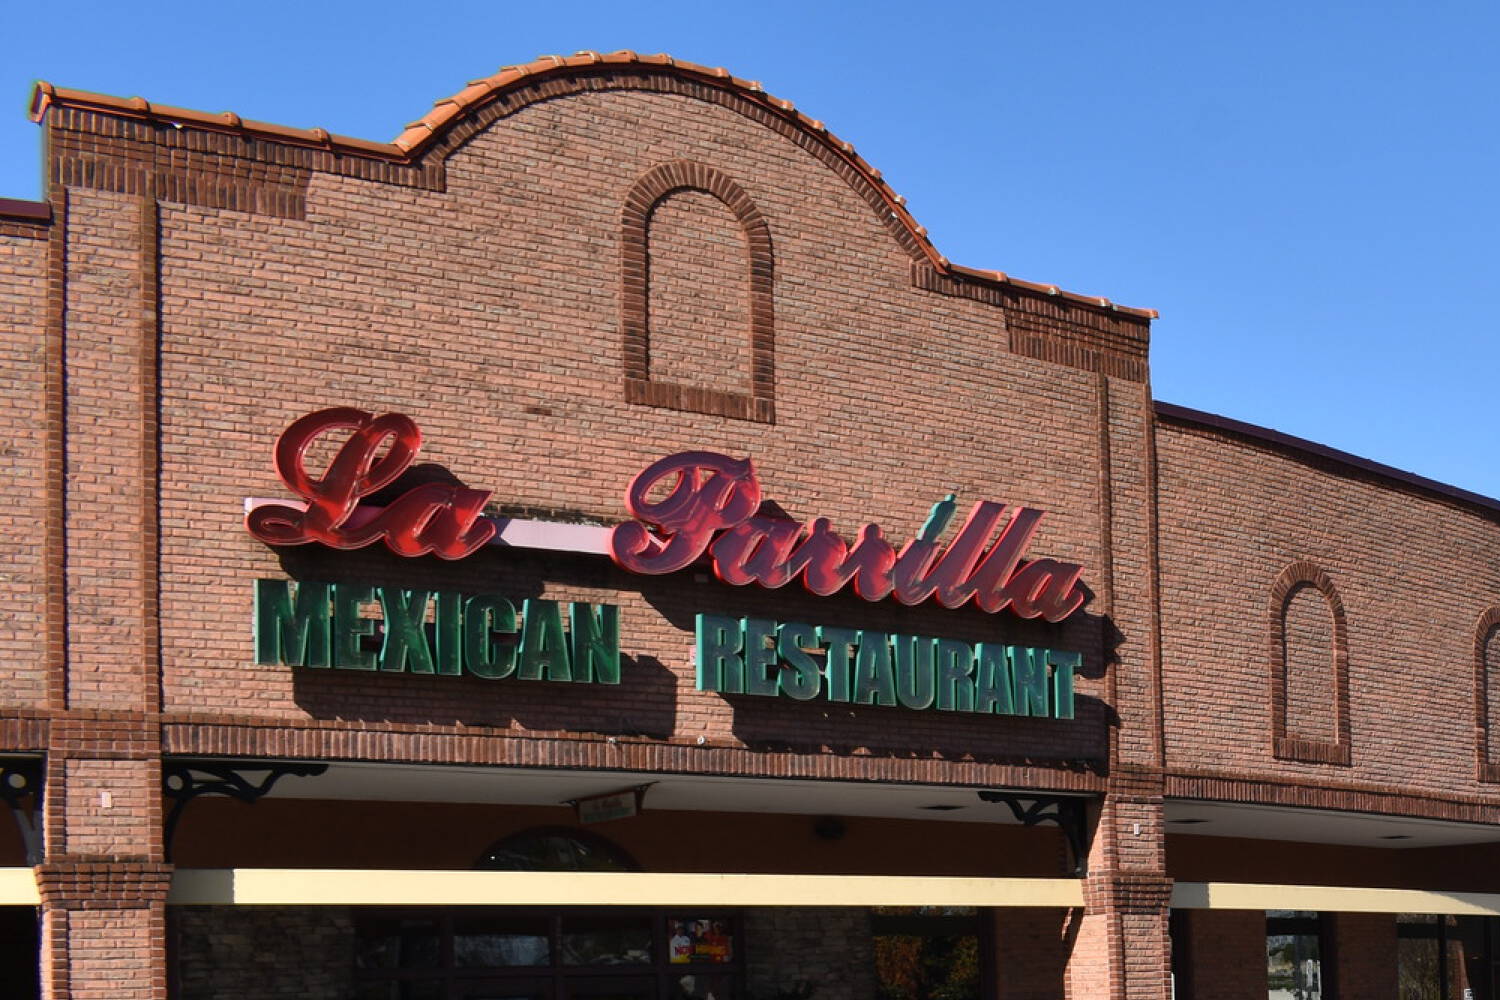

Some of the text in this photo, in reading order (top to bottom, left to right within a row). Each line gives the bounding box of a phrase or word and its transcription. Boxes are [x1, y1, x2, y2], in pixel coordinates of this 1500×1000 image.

[245, 406, 1086, 623] La Parrilla
[253, 578, 1082, 720] MEXICAN RESTAURANT
